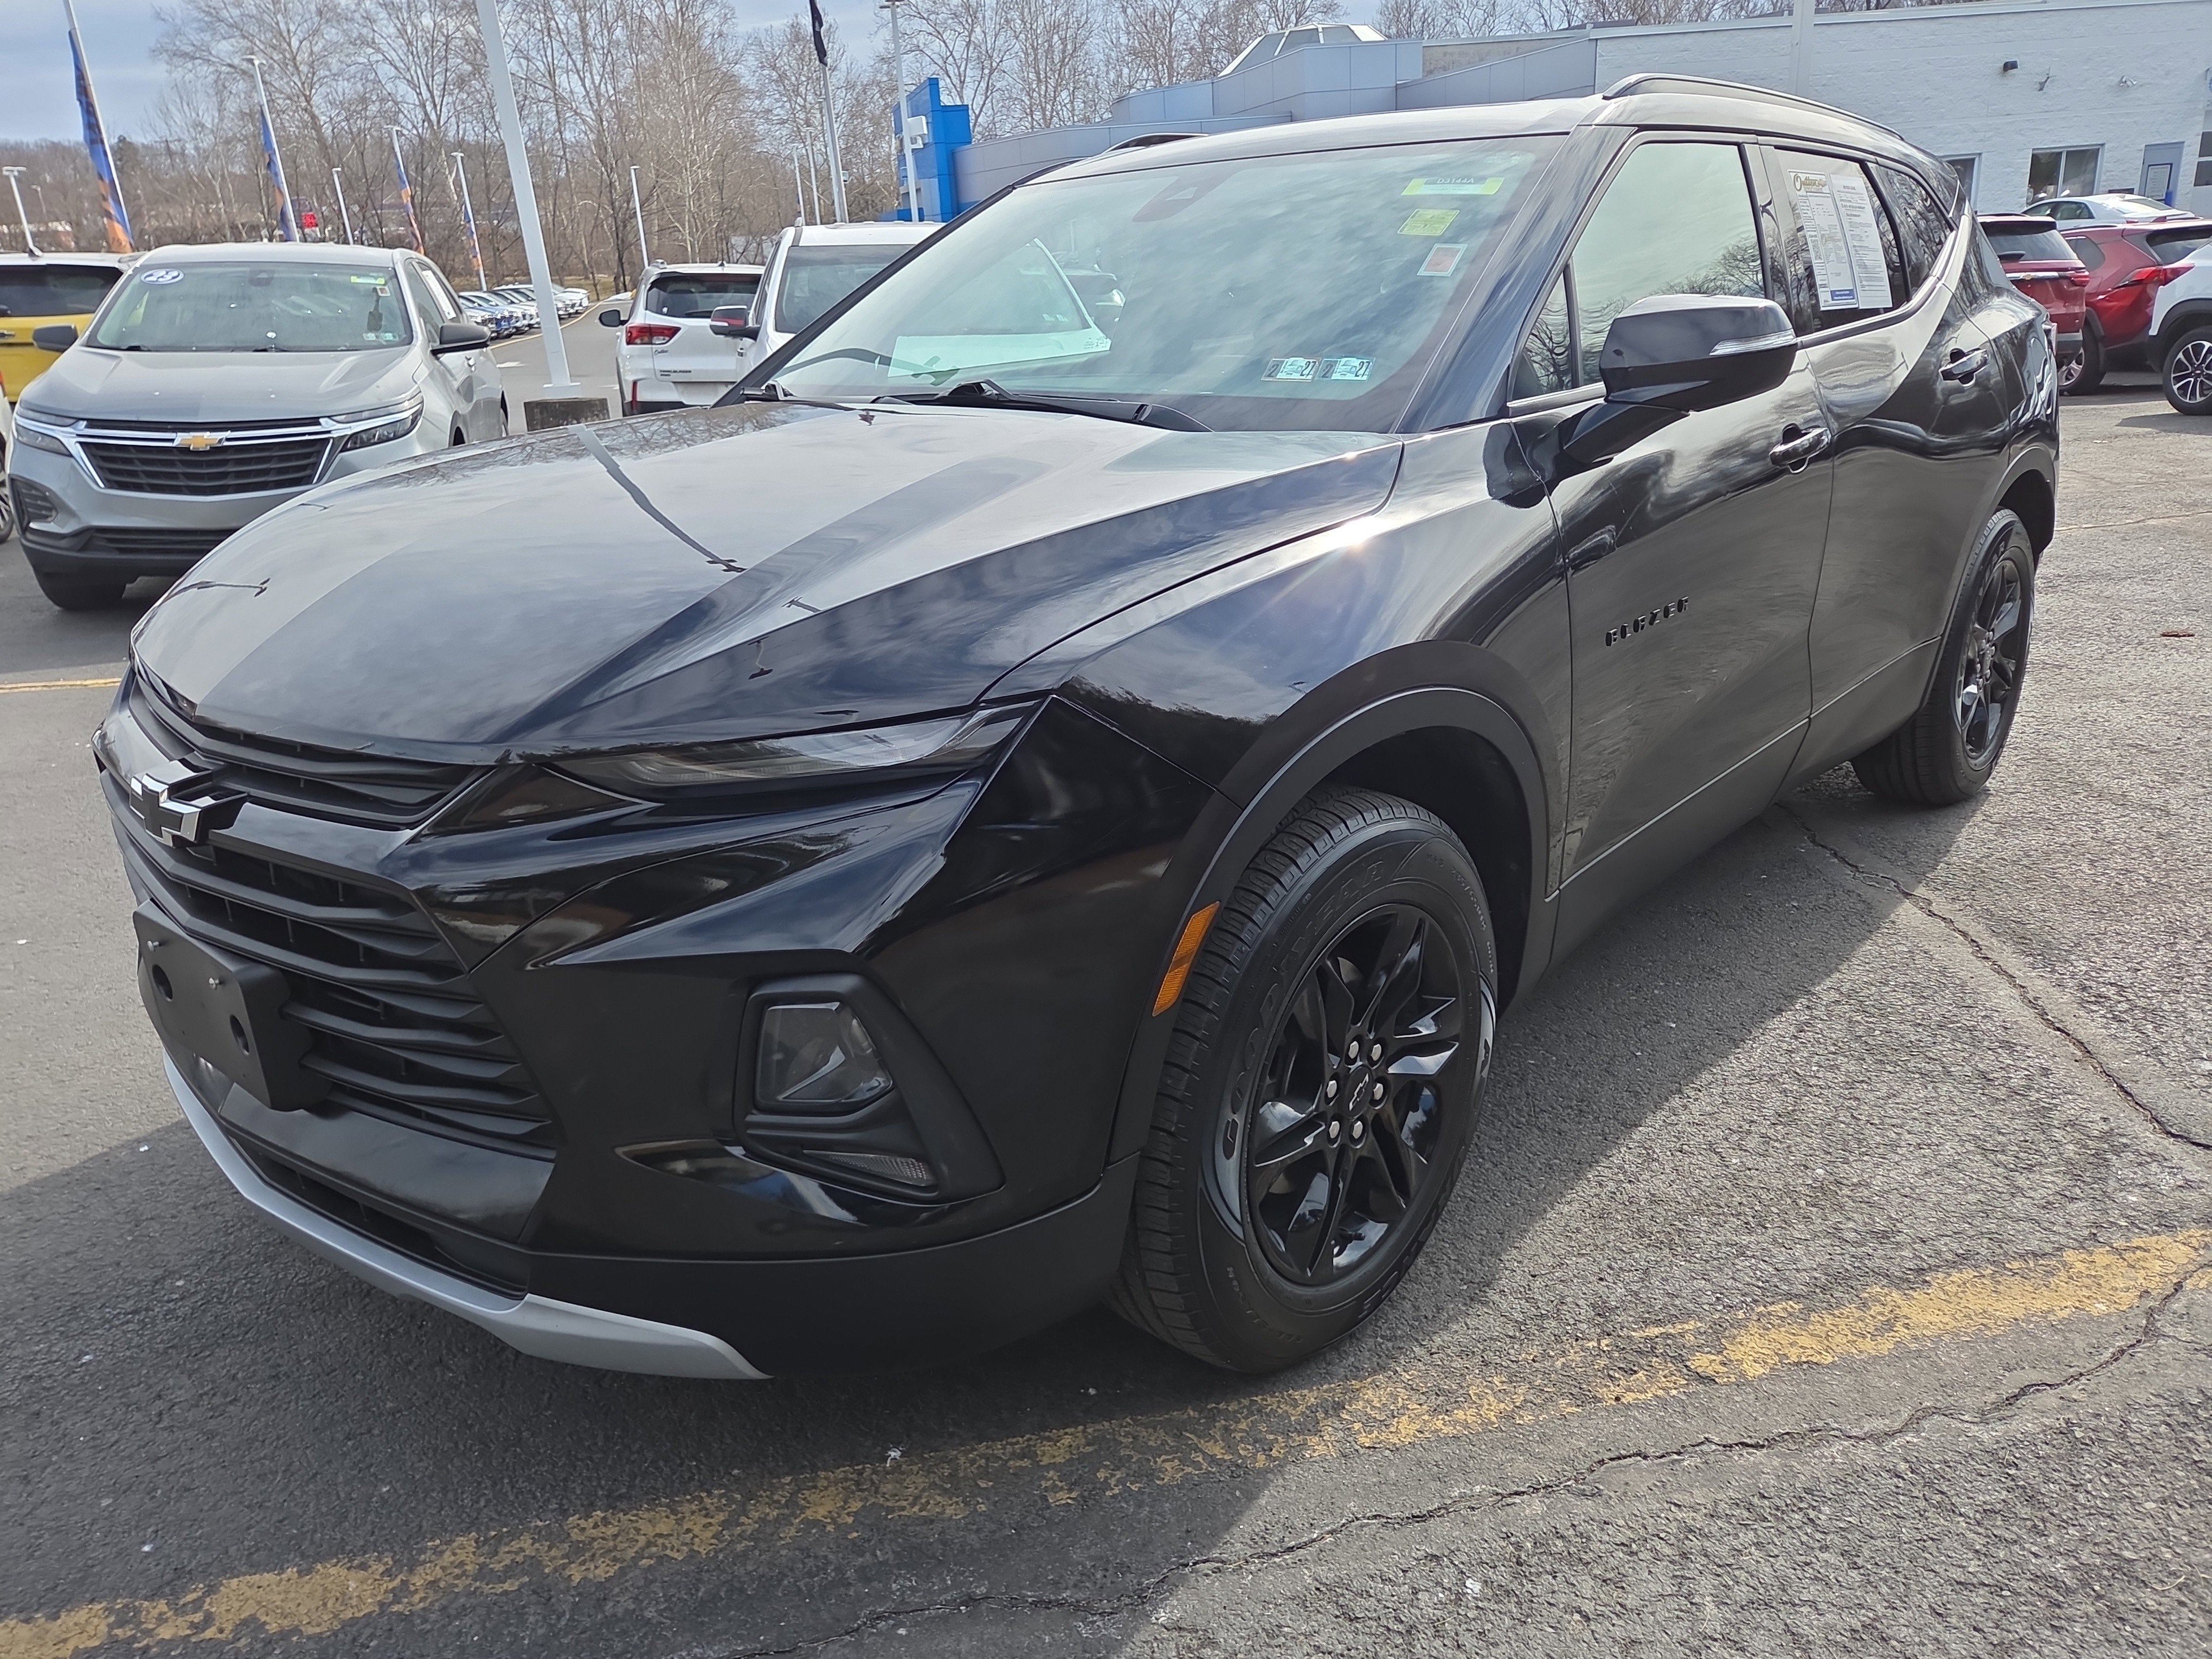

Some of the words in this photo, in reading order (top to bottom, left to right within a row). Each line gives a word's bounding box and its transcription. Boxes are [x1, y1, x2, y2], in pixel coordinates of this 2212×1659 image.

[1267, 363, 1279, 378] 2
[1300, 361, 1317, 378] 27
[1321, 364, 1334, 378] 2
[1354, 361, 1371, 378] 27
[1605, 595, 1690, 647] BLAZER
[1221, 858, 1385, 1160] GOODYEAR
